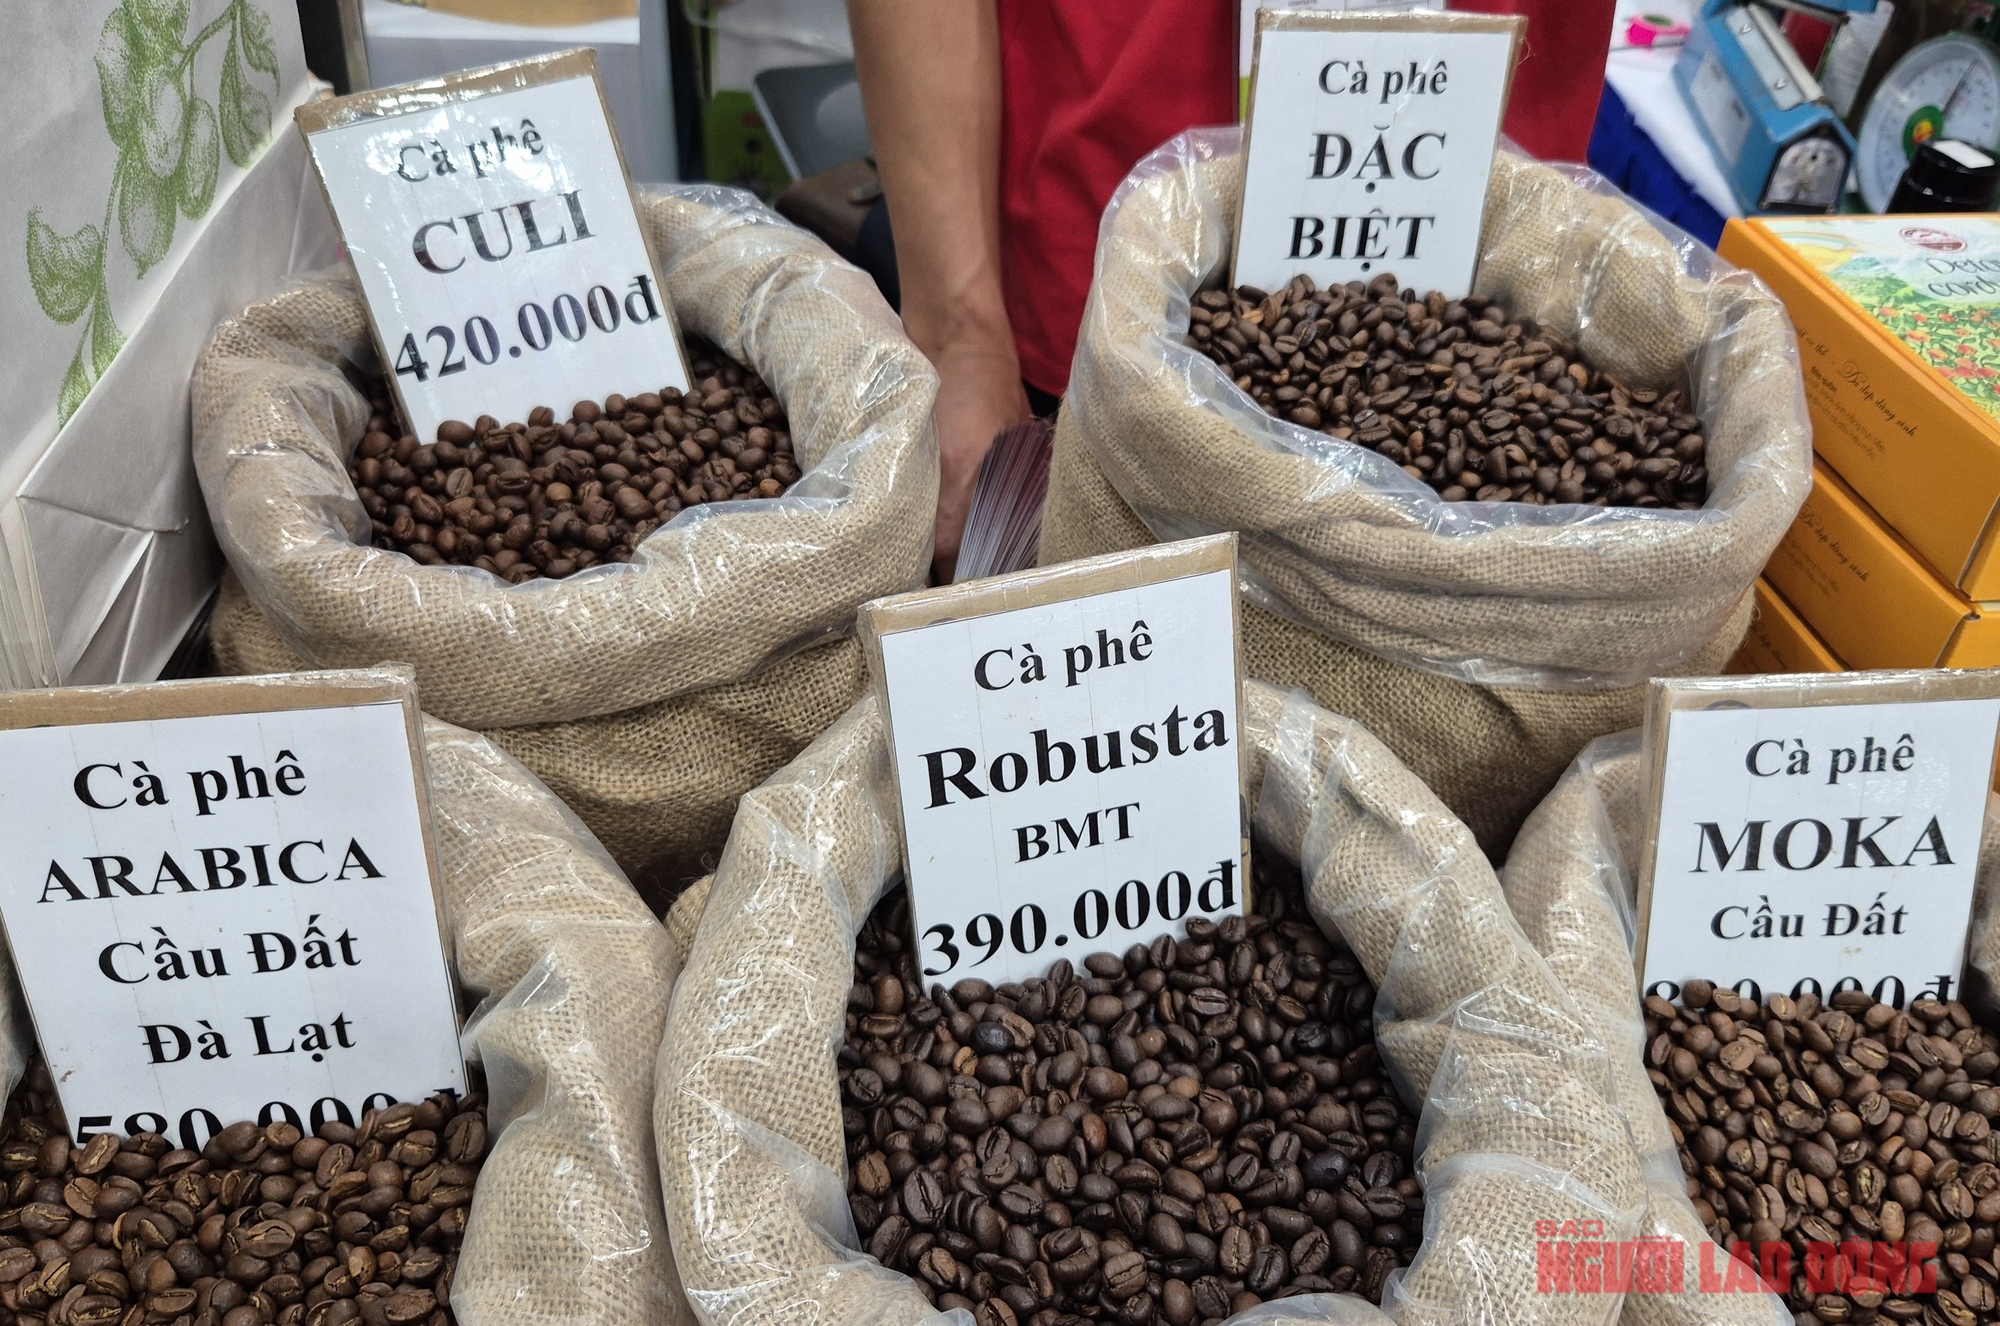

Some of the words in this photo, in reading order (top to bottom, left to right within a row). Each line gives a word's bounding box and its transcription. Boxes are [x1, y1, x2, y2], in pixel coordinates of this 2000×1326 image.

[1318, 60, 1368, 95] Cà
[1379, 60, 1448, 104] phê
[396, 139, 457, 182] Cà
[466, 118, 545, 180] phê
[1306, 124, 1446, 194] ĐẶC
[412, 189, 597, 275] CULI
[1284, 208, 1435, 272] BIỆT
[394, 274, 662, 383] 420.000đ
[974, 643, 1047, 691] Cà
[1063, 619, 1154, 688] phê
[73, 760, 170, 810] Cà
[186, 749, 307, 816] phê
[917, 704, 1230, 811] Robusta
[1745, 738, 1810, 777] Cà
[1825, 733, 1915, 785] phê
[1012, 802, 1141, 864] BMT
[1688, 814, 1956, 873] MOKA
[37, 836, 386, 904] ARABICA
[98, 926, 231, 984] Cầu
[243, 914, 362, 974] Đất
[922, 858, 1238, 976] 390.000đ
[1710, 895, 1804, 940] Cầu
[1820, 892, 1909, 937] Đất
[138, 1020, 232, 1065] Đà
[245, 1012, 357, 1063] Lạt
